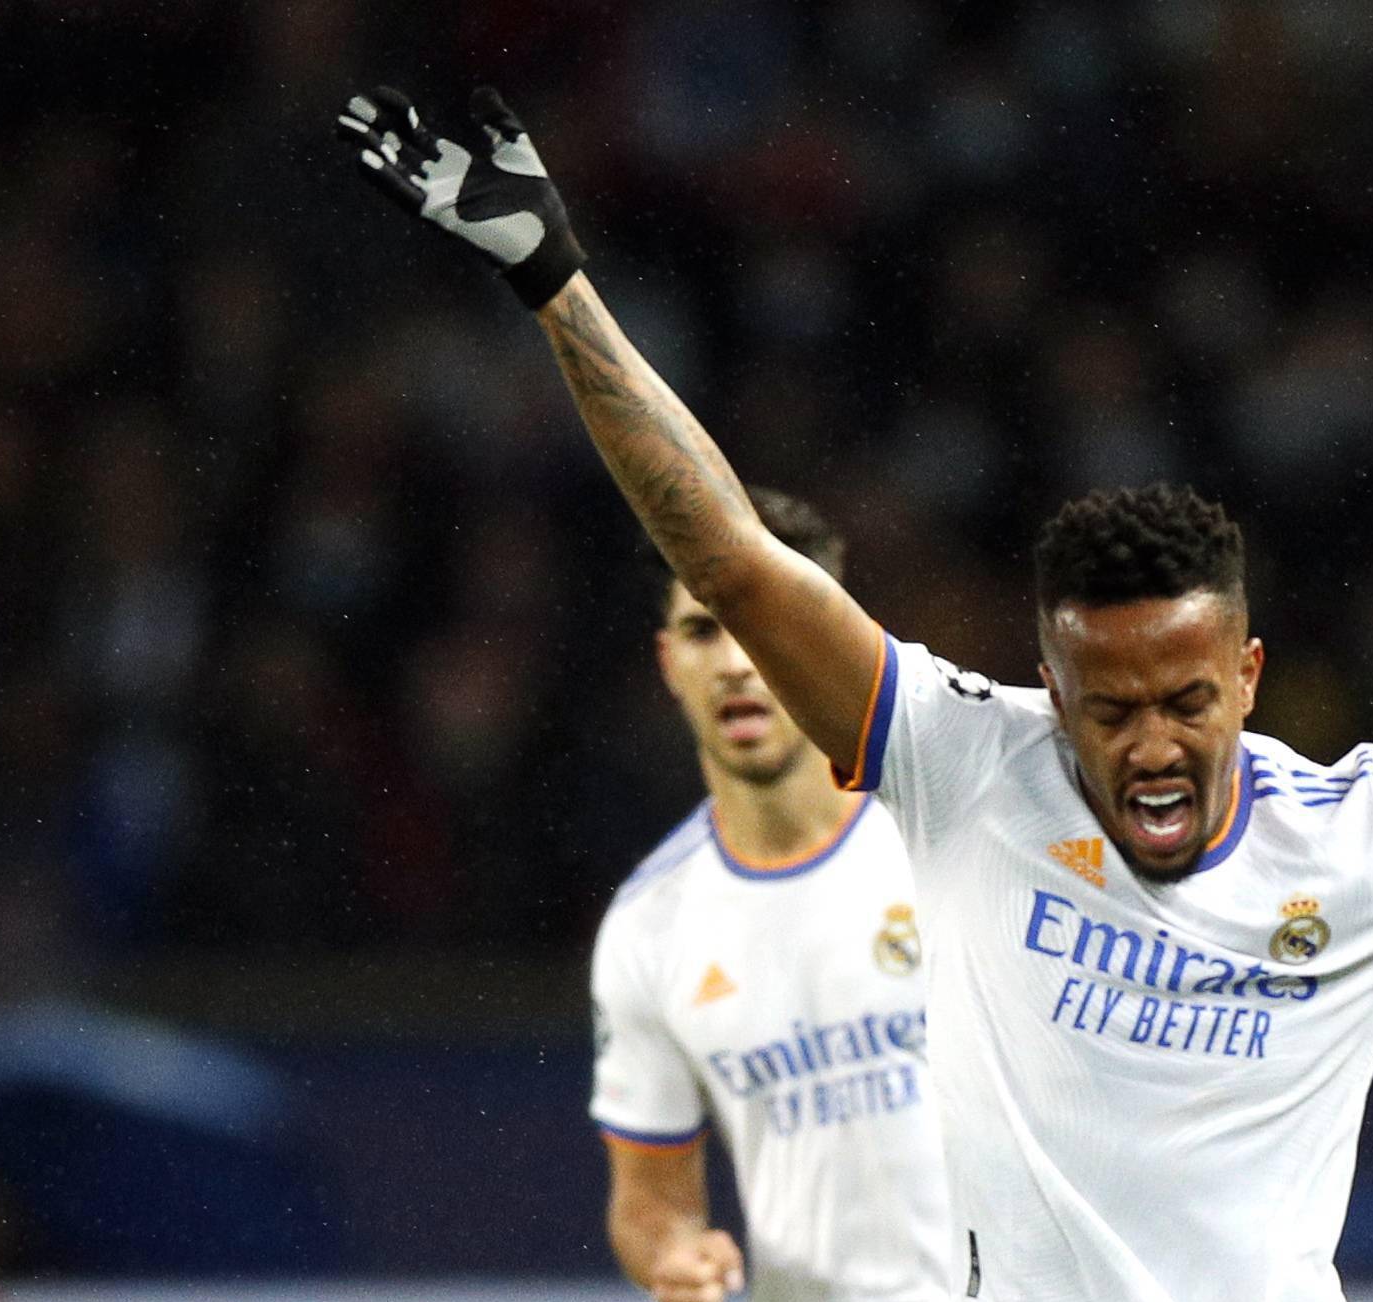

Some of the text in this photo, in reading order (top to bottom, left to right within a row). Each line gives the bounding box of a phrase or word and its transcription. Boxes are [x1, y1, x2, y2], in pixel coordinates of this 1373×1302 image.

[708, 1006, 927, 1098] Emirate
[1051, 977, 1272, 1060] FLY BETTER
